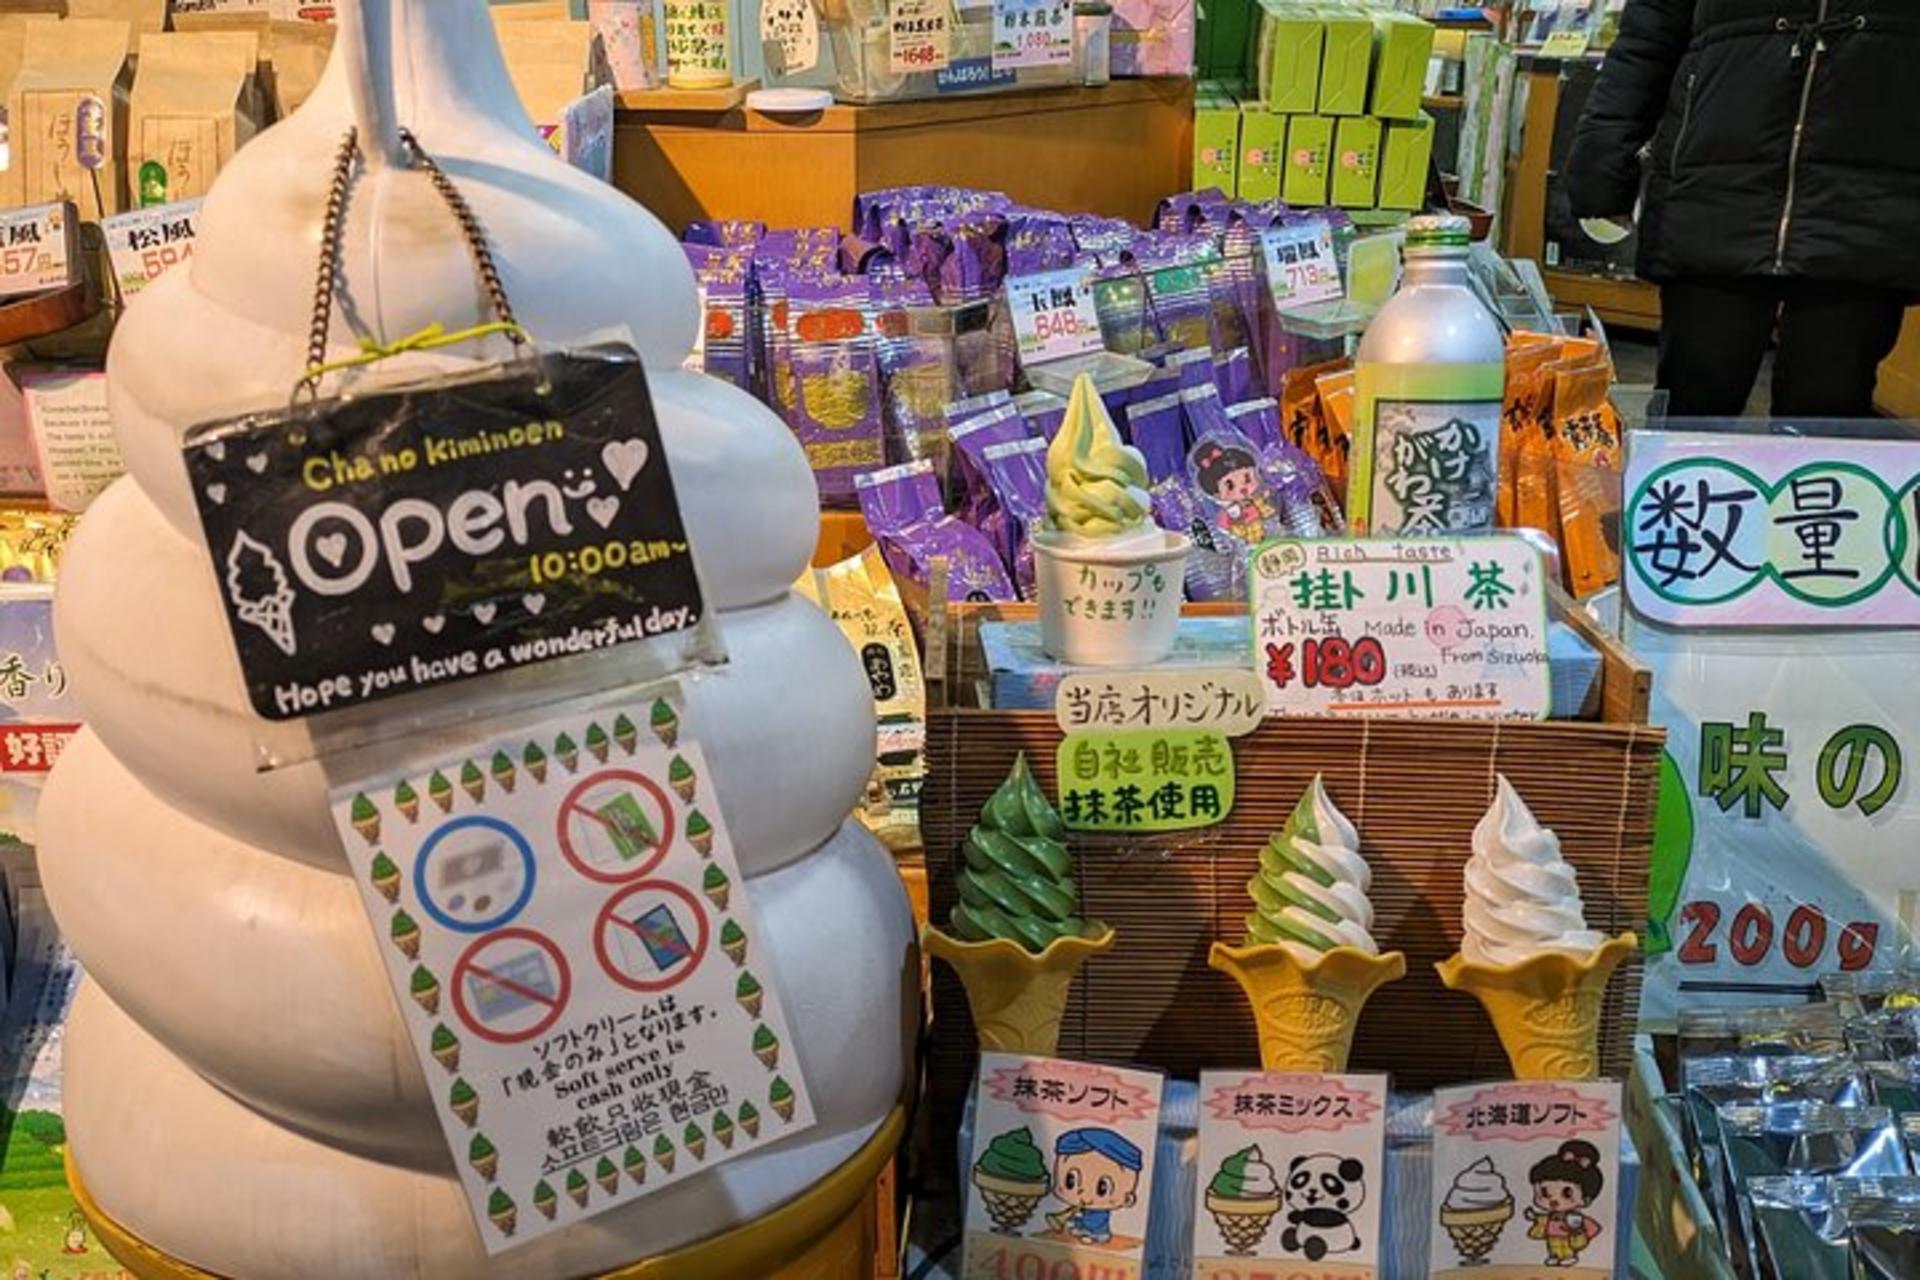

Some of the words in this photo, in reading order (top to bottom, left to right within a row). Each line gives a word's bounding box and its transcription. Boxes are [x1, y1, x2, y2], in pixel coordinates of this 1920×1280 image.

[0, 221, 42, 249] 風
[0, 248, 51, 276] 57円
[303, 455, 373, 491] Cha
[377, 447, 418, 475] no
[288, 478, 573, 597] Open
[1316, 543, 1367, 561] Rich
[1633, 476, 1920, 588] 数量
[1289, 560, 1516, 612] 掛川茶
[1364, 616, 1417, 638] Made
[1423, 619, 1447, 637] in
[274, 672, 353, 716] Hope
[359, 661, 407, 702] you
[411, 648, 477, 687] have
[482, 646, 505, 670] a
[509, 613, 645, 665] wonderful
[644, 604, 697, 640] day.
[1265, 636, 1388, 690] ¥180
[1440, 647, 1484, 664] From
[1065, 681, 1261, 726] 当店オリジナル
[1699, 711, 1902, 819] 味の
[1063, 781, 1222, 826] 抹茶使用
[1677, 900, 1879, 972] 200g
[533, 994, 679, 1061] ソフトクリームは
[553, 1071, 601, 1100] Soft
[605, 1047, 663, 1077] serve
[575, 1080, 624, 1111] cash
[629, 1060, 675, 1090] only
[1011, 1074, 1130, 1110] 抹茶ソフト
[1233, 1091, 1354, 1119] 抹茶ミックス
[1465, 1102, 1588, 1130] 北海道ソフト
